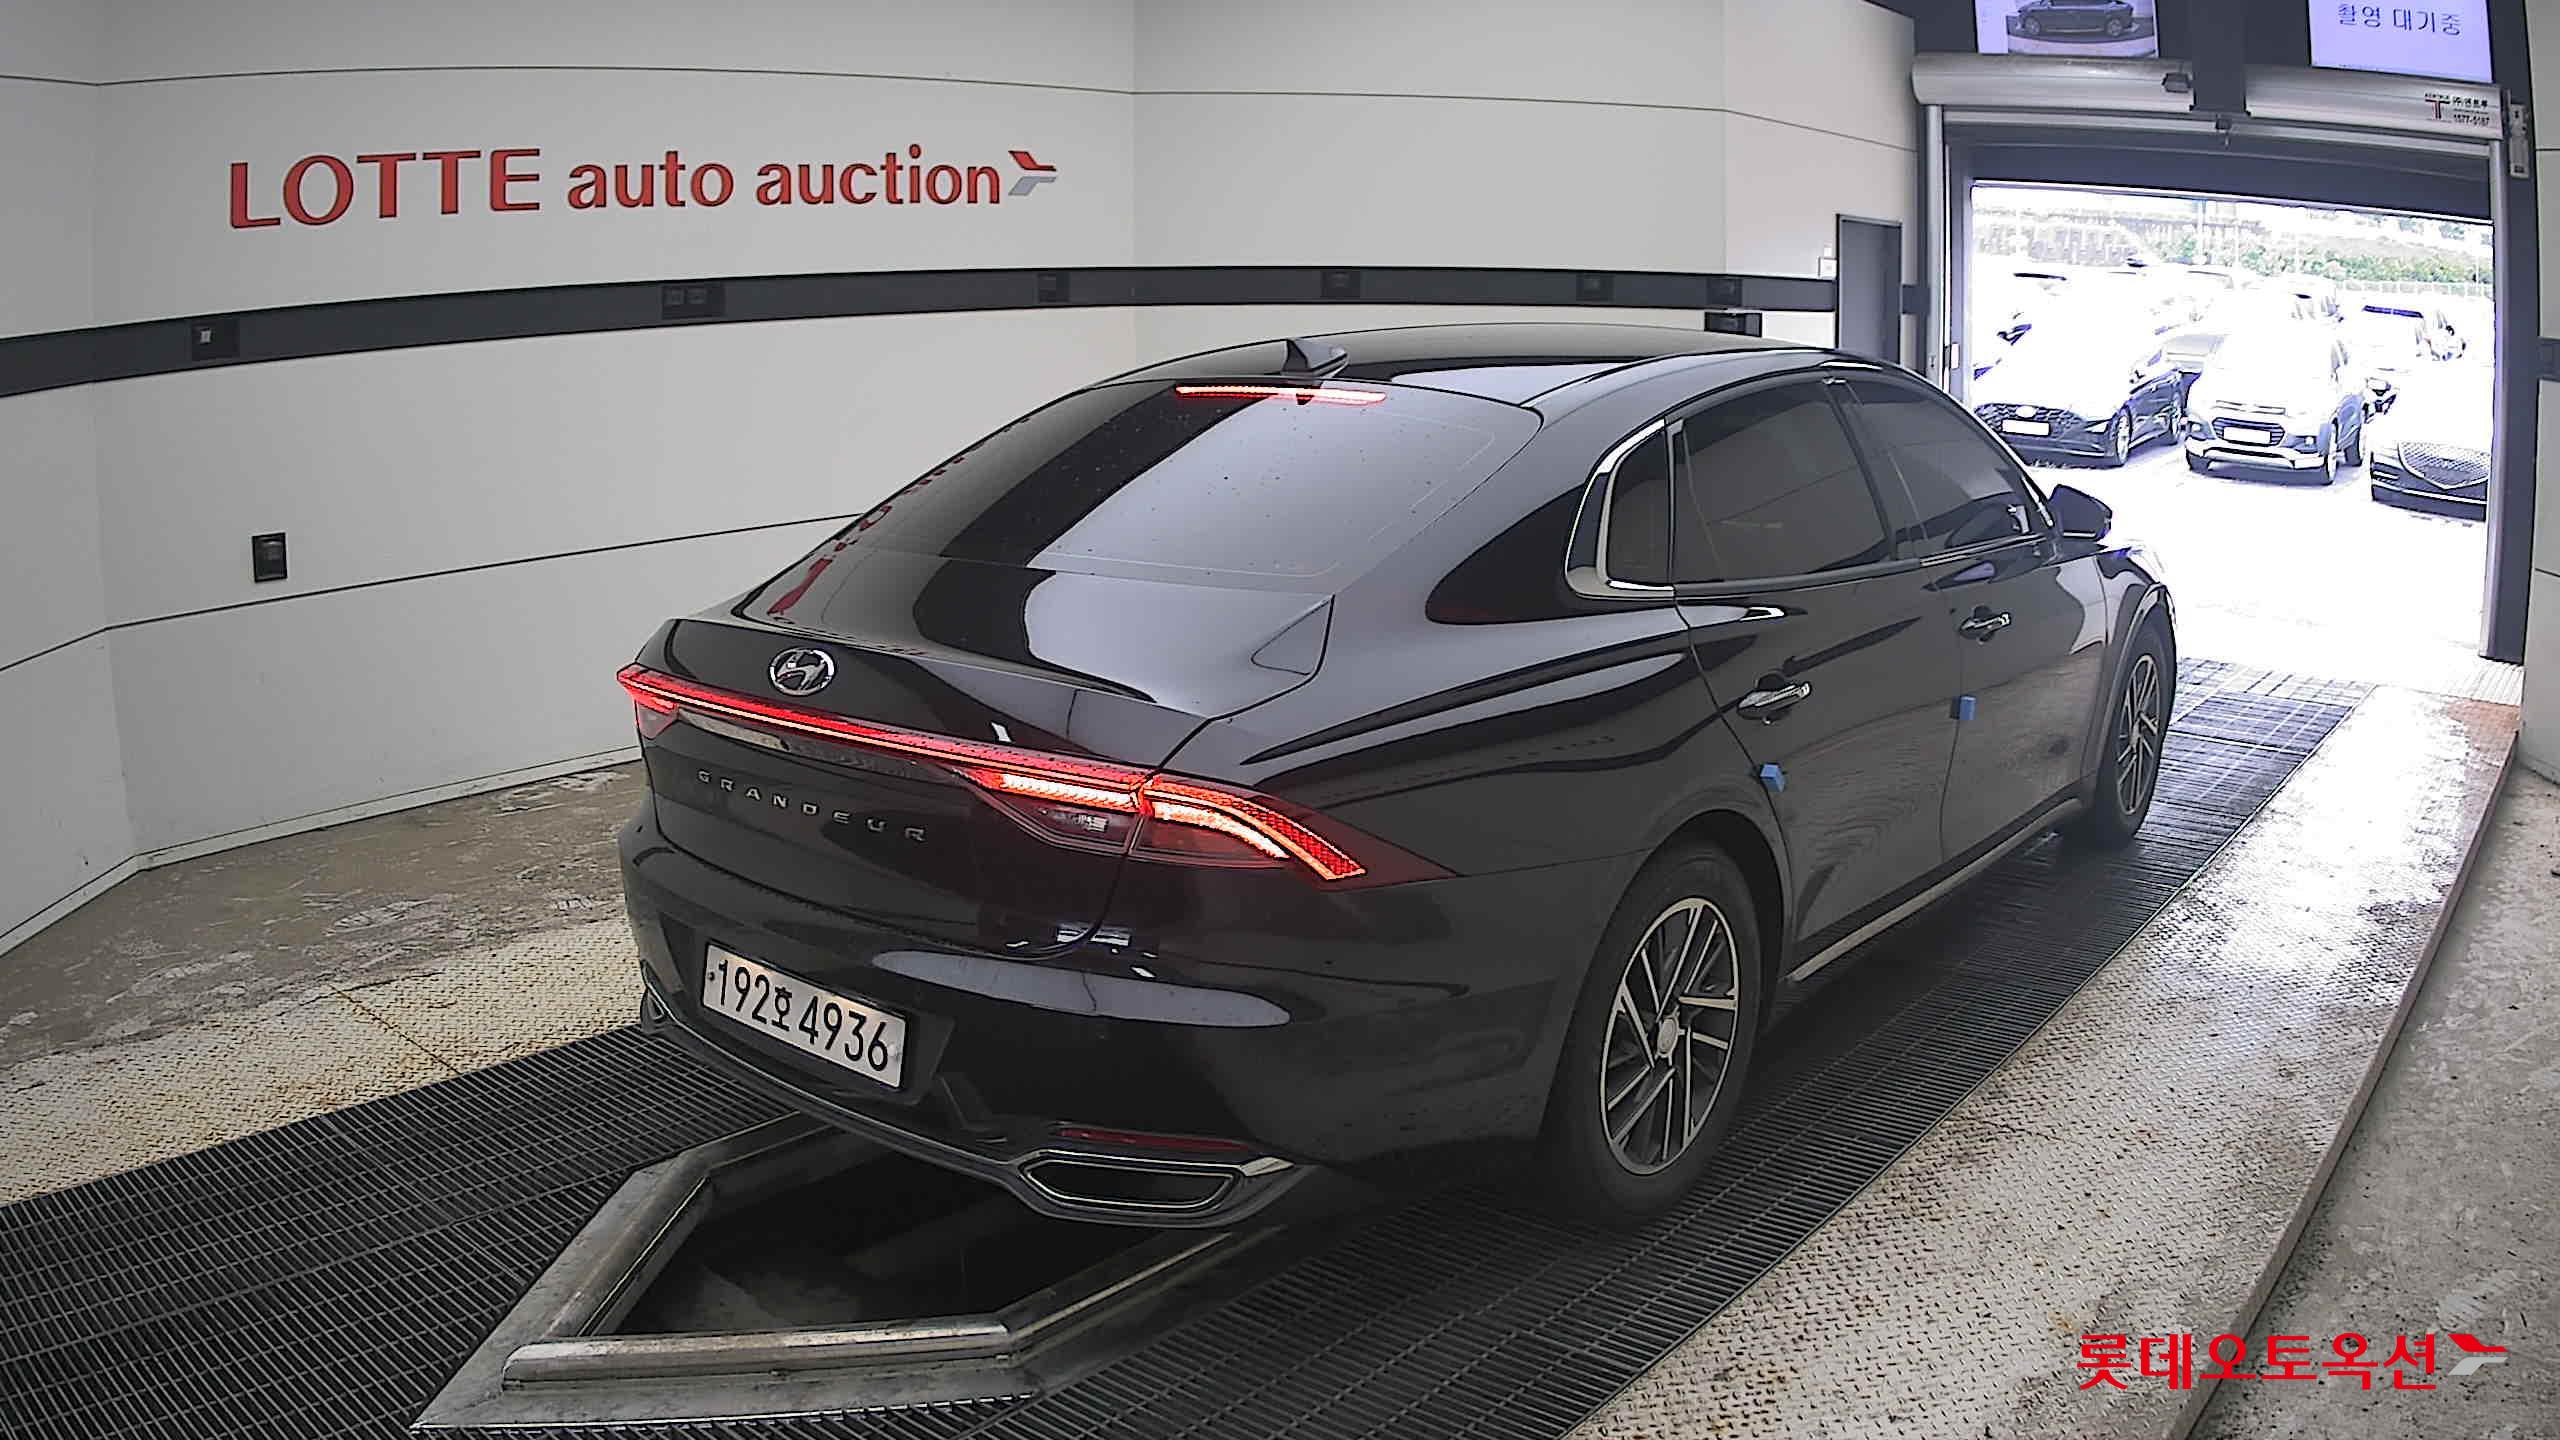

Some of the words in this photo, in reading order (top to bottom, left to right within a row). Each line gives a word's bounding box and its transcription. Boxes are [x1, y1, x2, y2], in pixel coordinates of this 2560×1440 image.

[2338, 4, 2382, 28] 촬영
[2392, 8, 2461, 36] 대기중
[231, 148, 539, 230] LOTTE
[567, 152, 736, 210] auto
[756, 145, 1002, 207] auction
[697, 770, 926, 843] GRANDEUR
[718, 958, 793, 1033] 192호
[798, 995, 889, 1072] 4936
